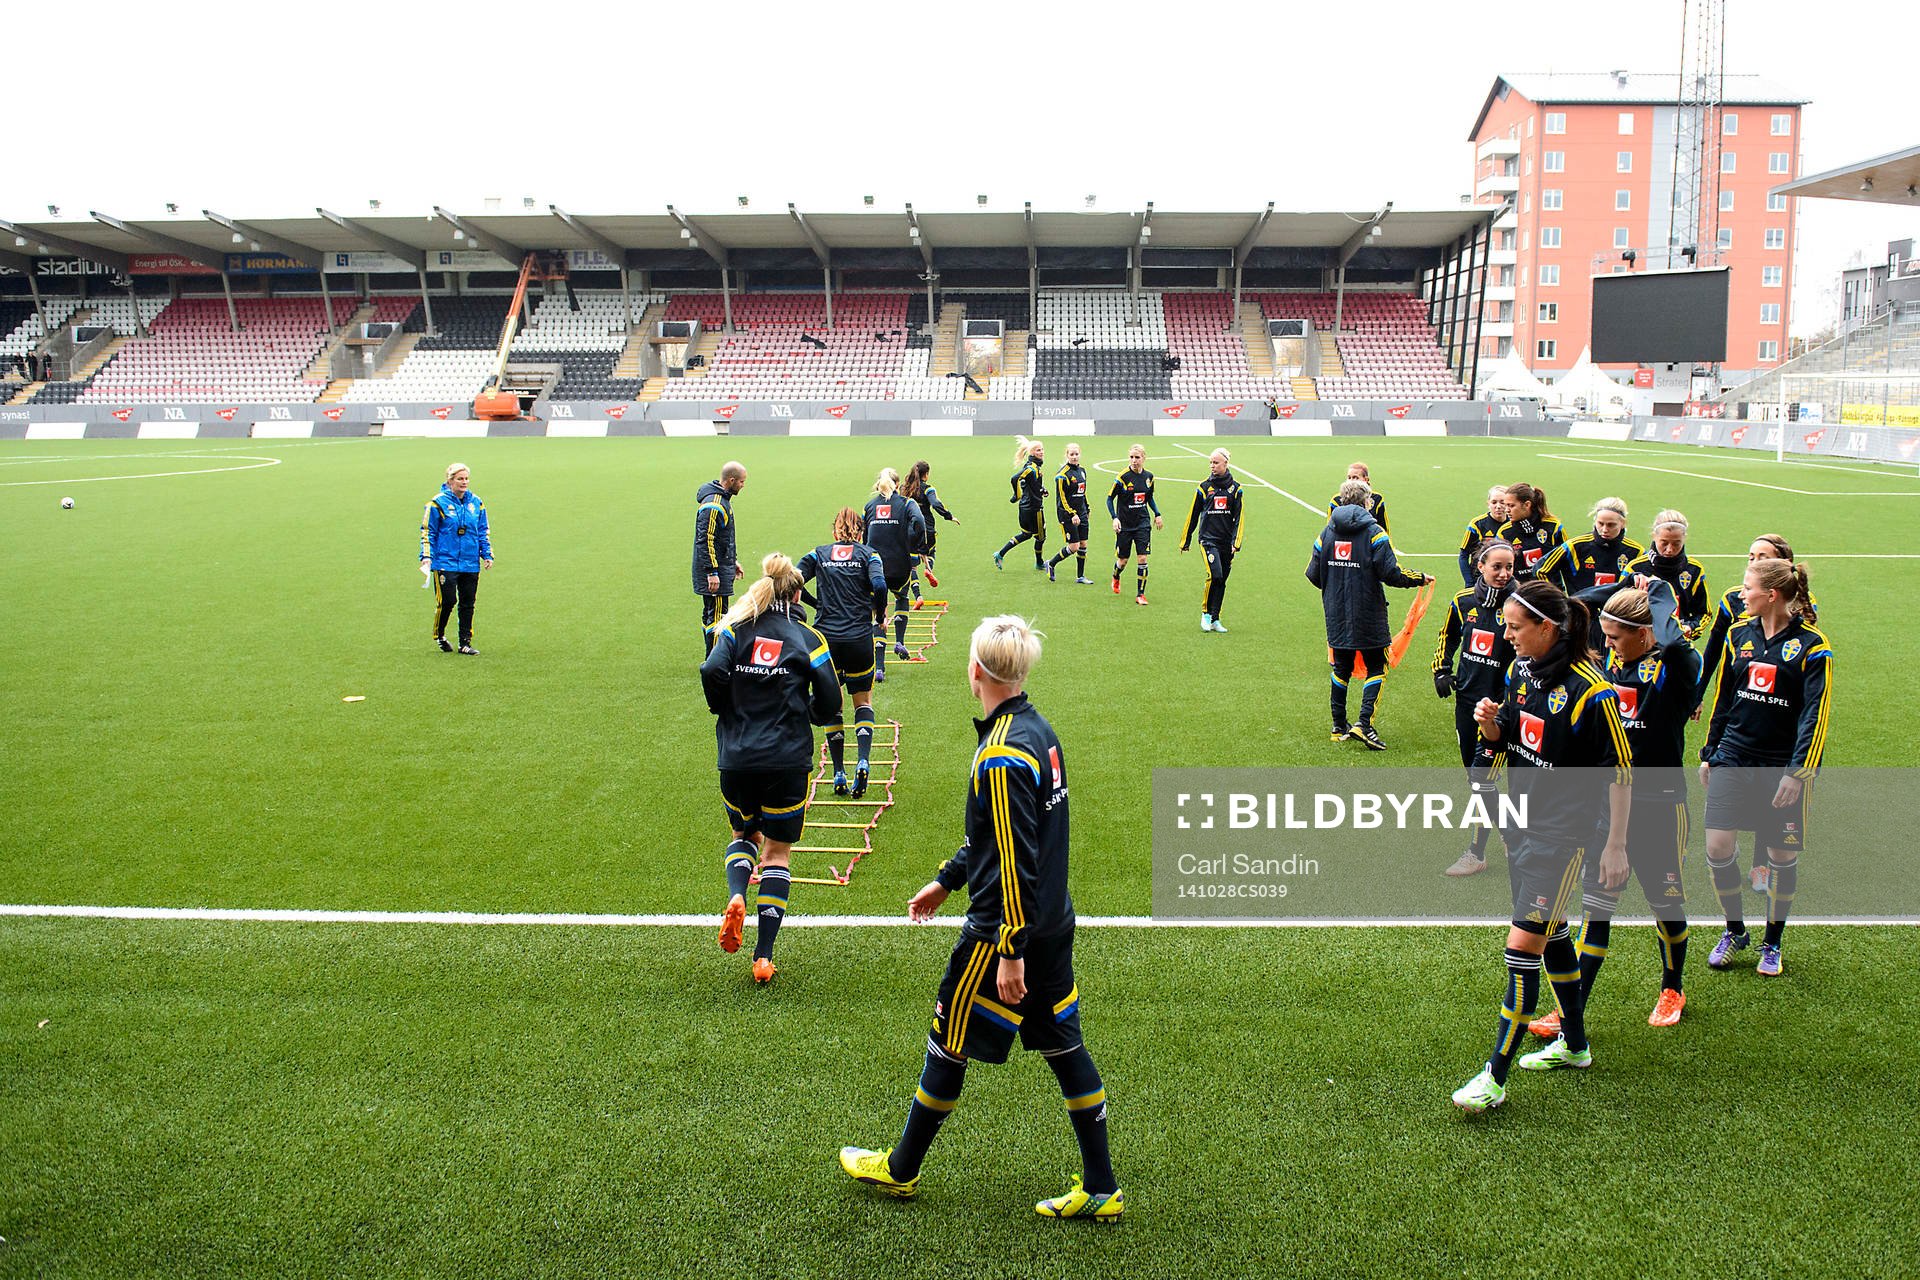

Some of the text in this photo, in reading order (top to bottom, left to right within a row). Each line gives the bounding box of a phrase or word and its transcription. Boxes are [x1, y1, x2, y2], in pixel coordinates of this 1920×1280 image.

[1, 409, 30, 421] synas!
[164, 407, 186, 420] NA
[270, 406, 292, 419] NA
[377, 406, 400, 419] NA
[551, 405, 574, 417] NA
[770, 404, 794, 417] NA
[941, 406, 951, 415] Vi
[1044, 406, 1075, 417] synas!
[1332, 404, 1355, 417] NA
[1499, 404, 1523, 418] NA
[735, 664, 770, 675] SVENSKA
[1767, 697, 1790, 707] SPEL
